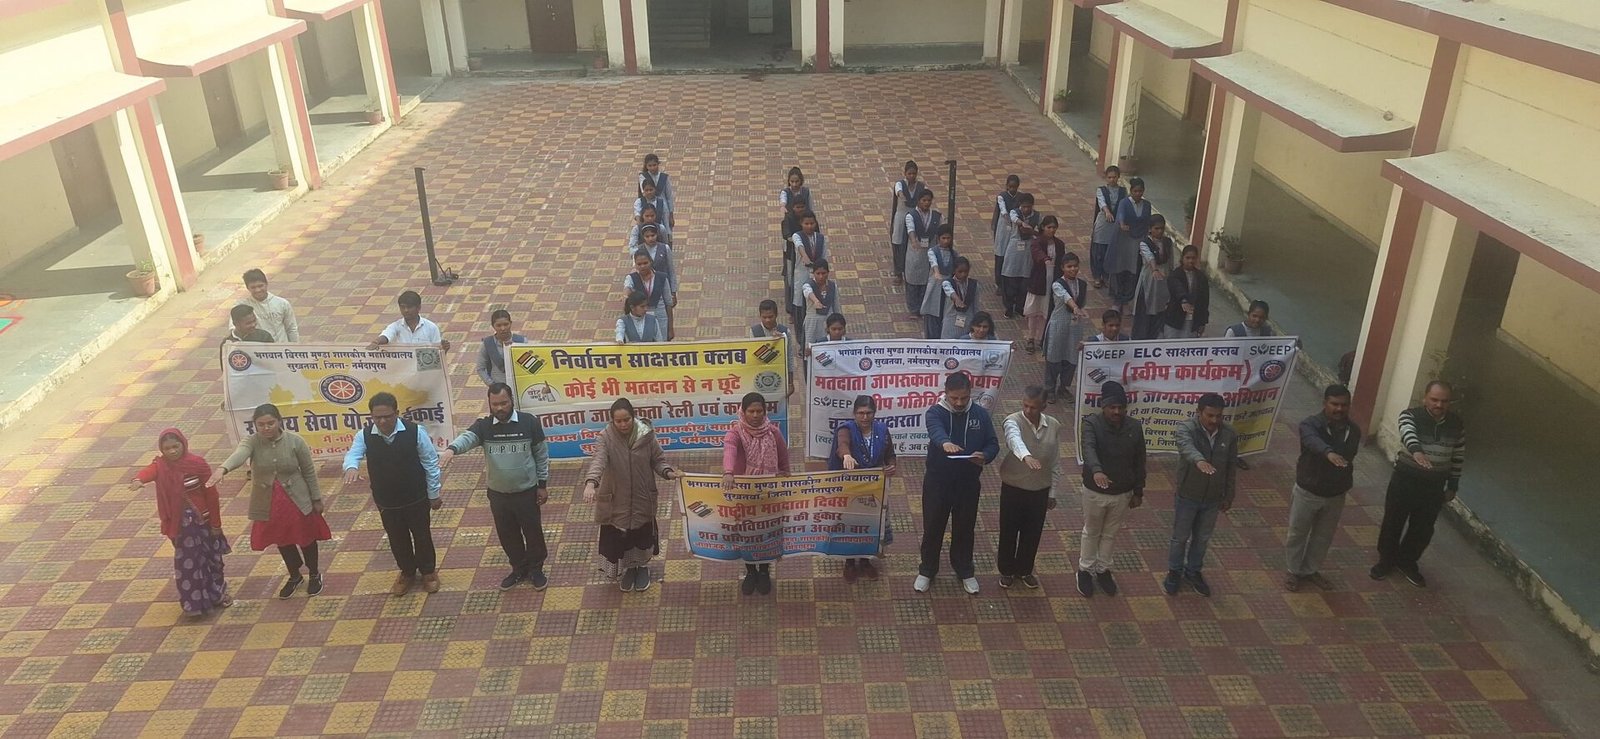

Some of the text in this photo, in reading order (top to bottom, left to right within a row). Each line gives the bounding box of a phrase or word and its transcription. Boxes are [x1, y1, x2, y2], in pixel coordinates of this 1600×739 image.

[254, 351, 283, 359] भगवान
[284, 348, 309, 359] बिरसा
[551, 348, 748, 369] निर्वाचन साक्षरता क्लब
[838, 348, 862, 356] भगवान
[864, 346, 884, 355] बिरसा
[906, 345, 938, 355] शासकीय
[939, 346, 982, 356] महाविद्यालय
[1134, 346, 1240, 358] ELC साक्षरता क्लब
[563, 377, 597, 400] कोई
[602, 378, 621, 396] भी
[624, 380, 678, 396] मतदान
[682, 375, 696, 393] से
[700, 379, 714, 392] न
[814, 375, 867, 391] मतदाता
[870, 373, 941, 389] जागरूकता
[698, 398, 720, 414] एवं
[303, 410, 338, 432] सेवा
[687, 480, 720, 489] भगवान
[760, 500, 810, 514] मतदाता
[814, 495, 849, 509] दिवस
[721, 514, 790, 533] महाविद्यालय
[794, 512, 809, 522] की
